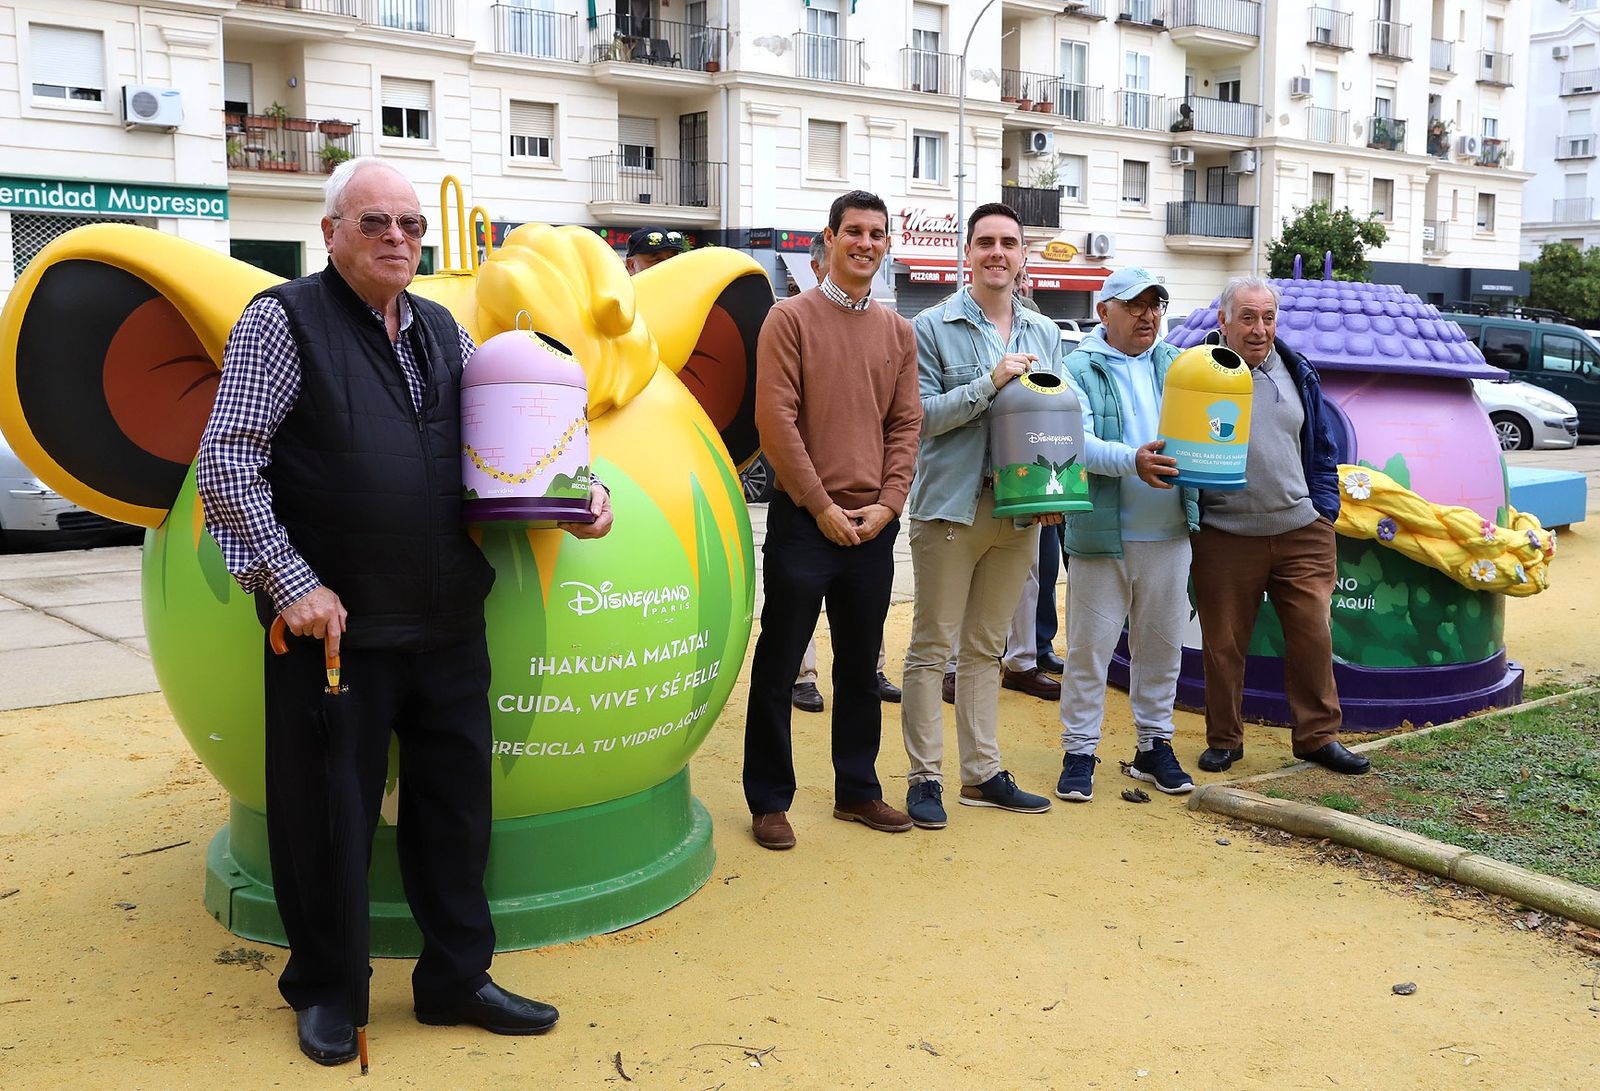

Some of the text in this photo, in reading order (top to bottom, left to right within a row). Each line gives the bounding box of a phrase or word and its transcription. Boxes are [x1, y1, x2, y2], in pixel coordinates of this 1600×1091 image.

[0, 183, 224, 216] ernidad Muprespa
[910, 271, 940, 281] PIZZERIA
[651, 602, 691, 616] PARIS
[1336, 594, 1375, 609] AQUÍ!
[643, 630, 709, 665] MATATA!
[497, 660, 721, 714] CUIDA, VIVE Y SÉ FELIZ
[491, 741, 585, 756] ¡RECICLA
[593, 738, 617, 753] TU
[621, 722, 673, 748] VIDRIO
